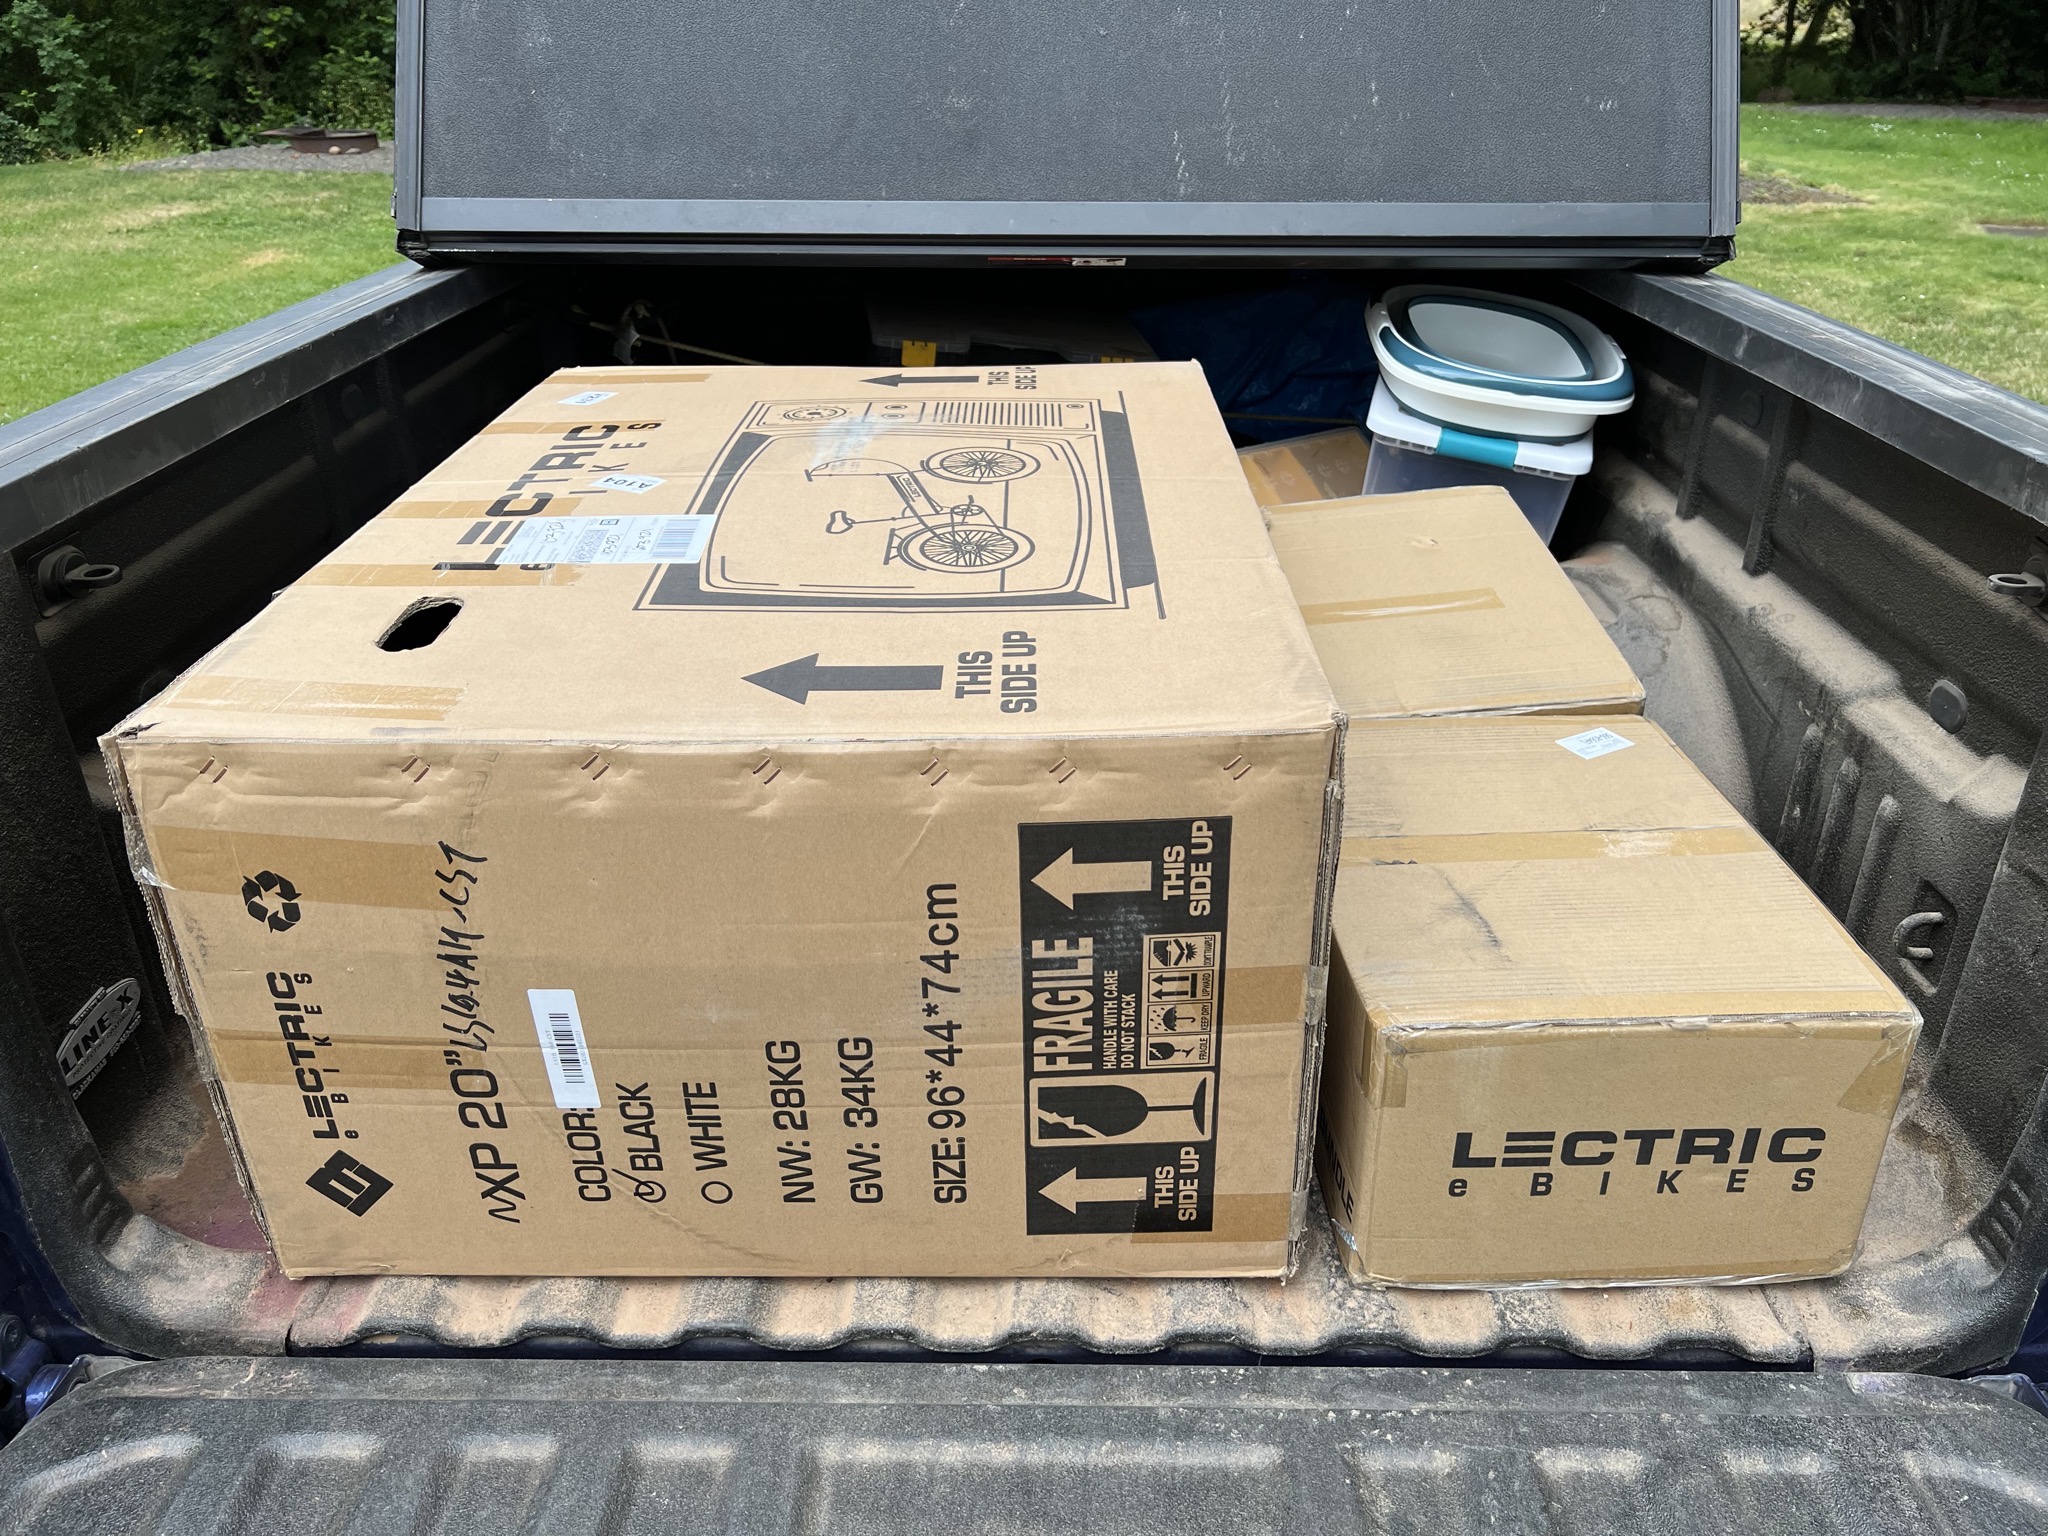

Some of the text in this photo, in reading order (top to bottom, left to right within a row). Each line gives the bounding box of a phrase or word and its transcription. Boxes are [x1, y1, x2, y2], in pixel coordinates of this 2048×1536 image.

[987, 371, 1009, 385] THIS
[1015, 375, 1037, 390] SIDE
[432, 425, 620, 571] LECTRIC
[955, 652, 992, 698] THIS
[1001, 632, 1036, 713] SIDE UP
[1163, 846, 1184, 900] THIS
[1190, 821, 1212, 916] SIDE UP
[1032, 937, 1093, 1071] FRAGILE
[1103, 970, 1118, 1069] HANDLE WITH CARE
[1201, 1004, 1209, 1030] KEEP DRY
[1202, 973, 1210, 996] UPWARD
[266, 972, 339, 1138] LECTRIC
[1121, 994, 1135, 1068] DO NOT STACK
[1199, 1038, 1207, 1060] FRAGILE
[615, 1082, 663, 1171] BLACK
[682, 1082, 727, 1171] WHITE
[765, 1041, 815, 1202] NW: 28KG
[838, 1038, 883, 1203] GW: 34KG
[1452, 1128, 1825, 1167] LECTRIC
[932, 1137, 967, 1203] SIZE:
[1155, 1166, 1174, 1208] THIS
[1179, 1147, 1199, 1220] SIDE UP
